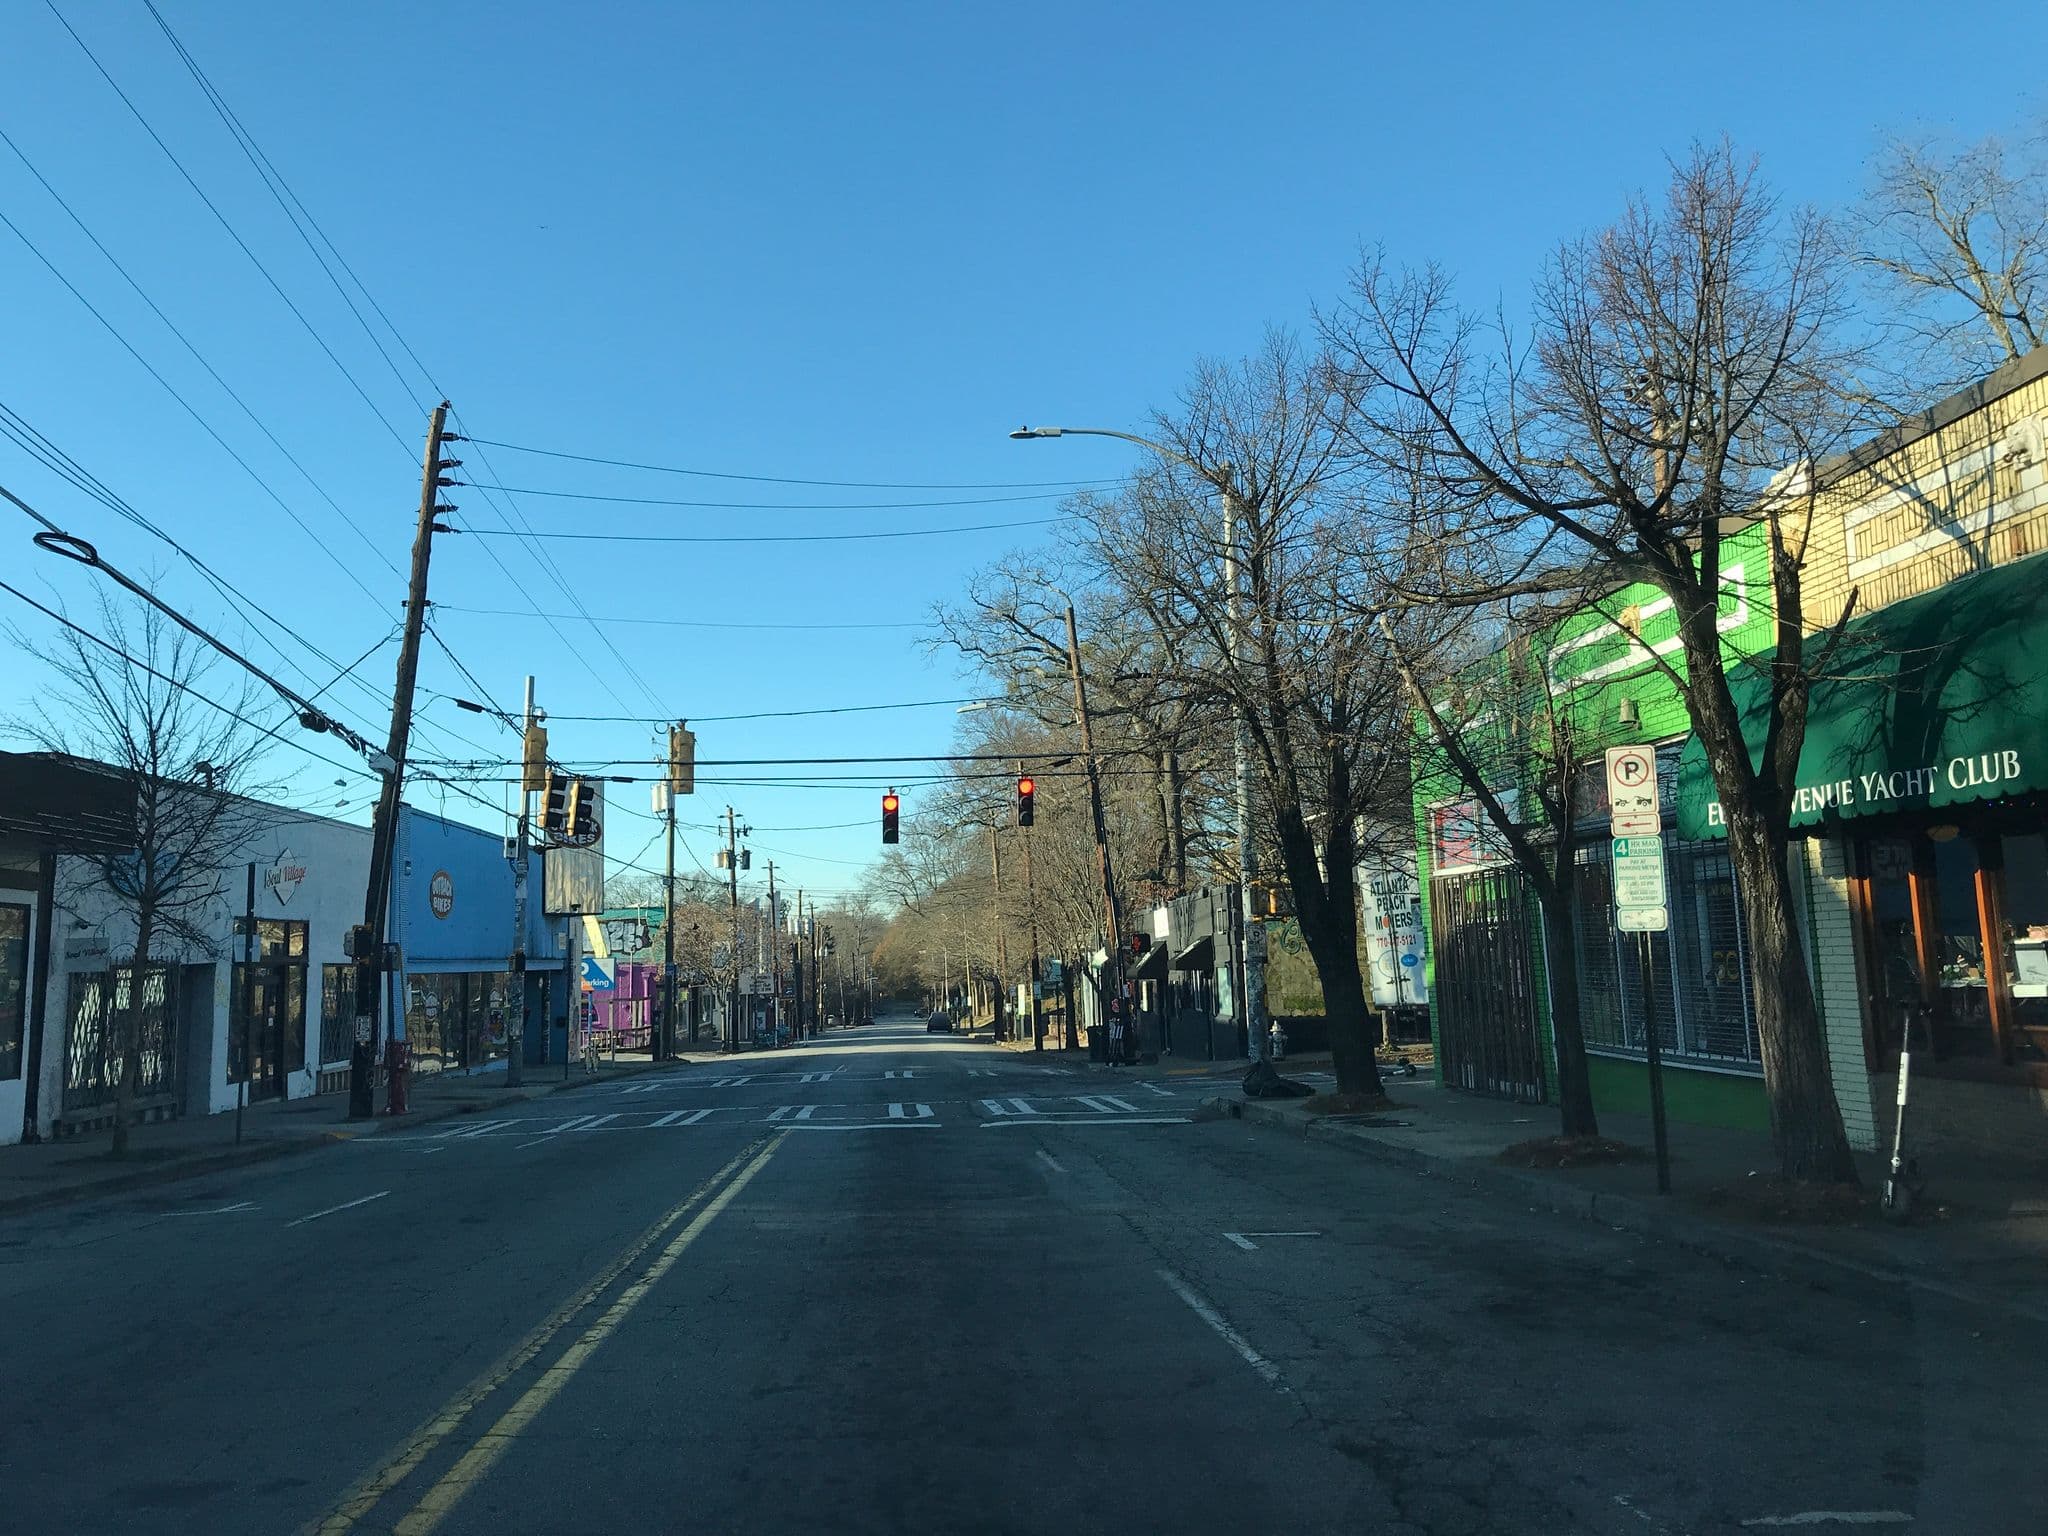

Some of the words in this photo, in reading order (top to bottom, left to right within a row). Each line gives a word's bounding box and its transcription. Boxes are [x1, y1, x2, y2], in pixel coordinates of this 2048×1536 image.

[1624, 761, 1639, 780] P
[1791, 779, 1855, 815] VENUE
[1860, 766, 1938, 801] YACHT
[1947, 750, 2021, 789] CLUB
[552, 832, 596, 845] BIKES
[1616, 840, 1628, 855] 4
[1370, 877, 1409, 896] ATLANTA
[433, 897, 451, 912] BIKES
[1376, 895, 1406, 912] PEACH
